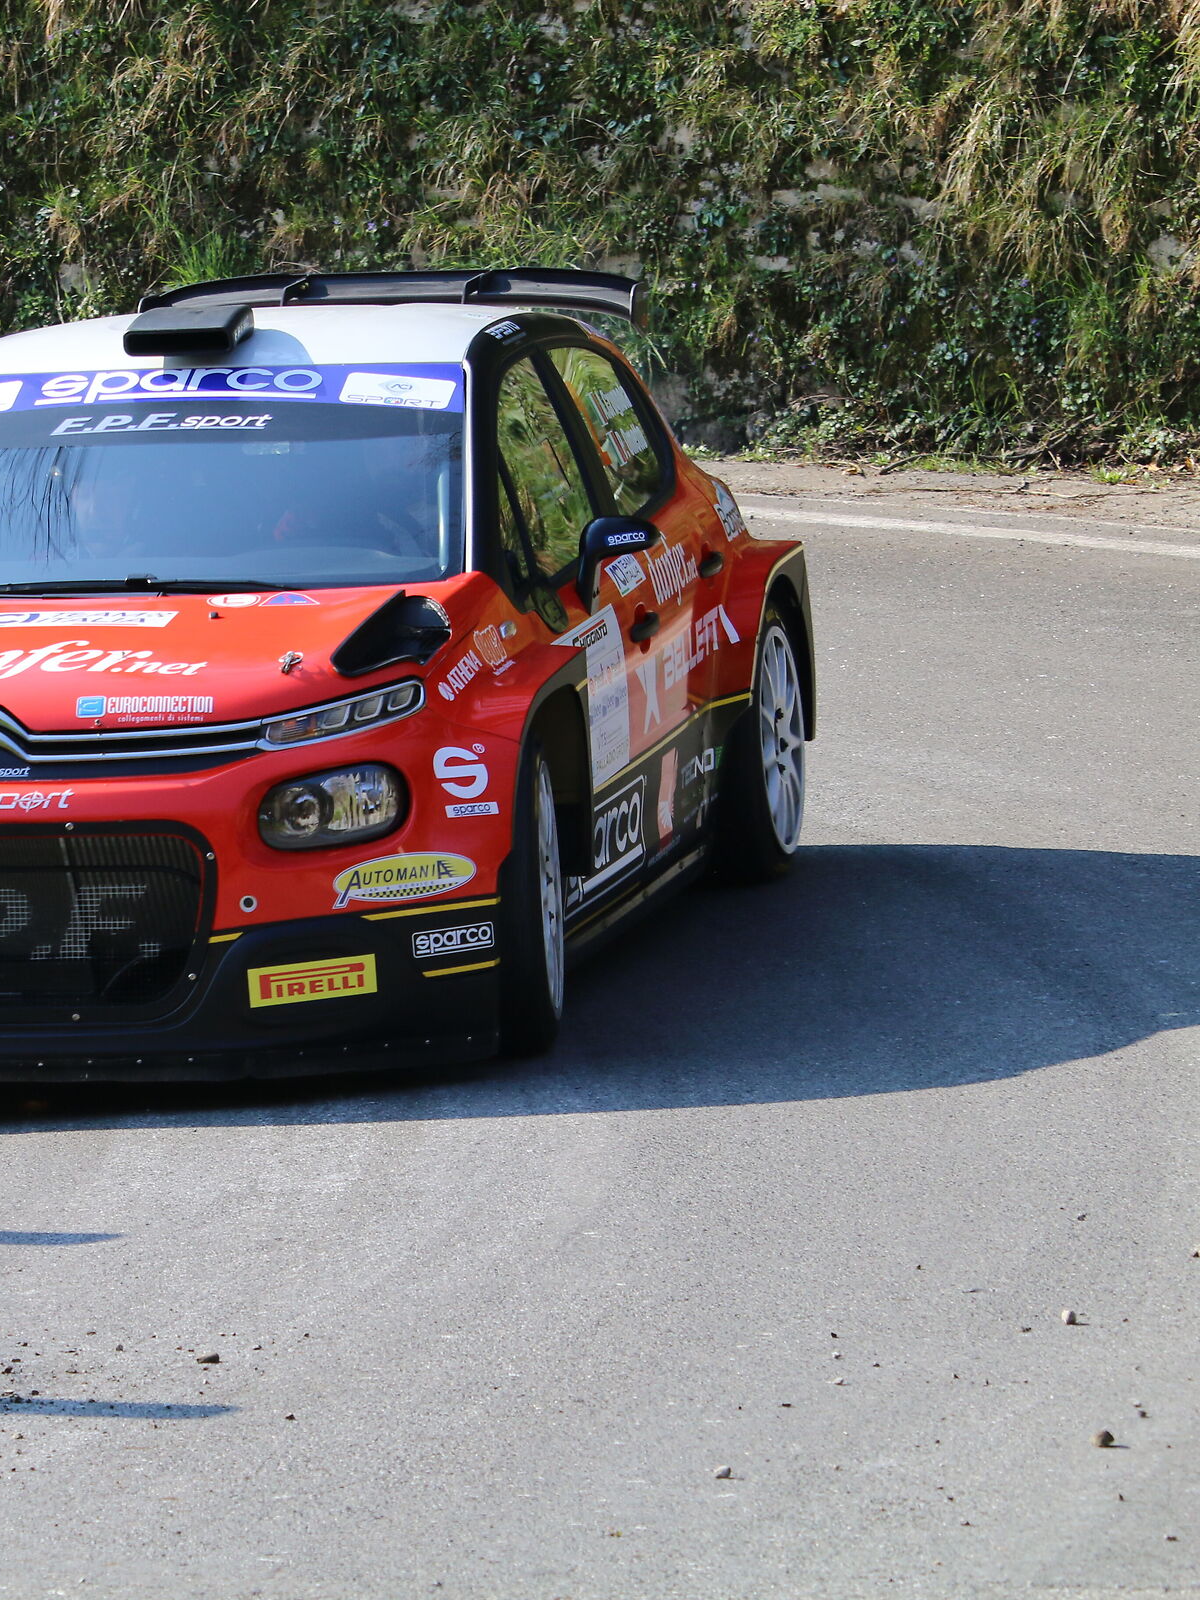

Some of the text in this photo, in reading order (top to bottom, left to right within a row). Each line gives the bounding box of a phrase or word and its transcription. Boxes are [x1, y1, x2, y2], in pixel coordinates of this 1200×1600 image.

[40, 367, 323, 405] sparco
[607, 531, 645, 546] sparco
[446, 649, 483, 695] ATHENA
[107, 695, 214, 714] EUROCONNECTION
[117, 714, 165, 724] collegamenti
[433, 746, 489, 800] S
[452, 803, 492, 816] sparco
[338, 860, 454, 905] AUTOMANIA
[415, 925, 492, 954] sparco
[259, 962, 365, 1000] PIRELLI
